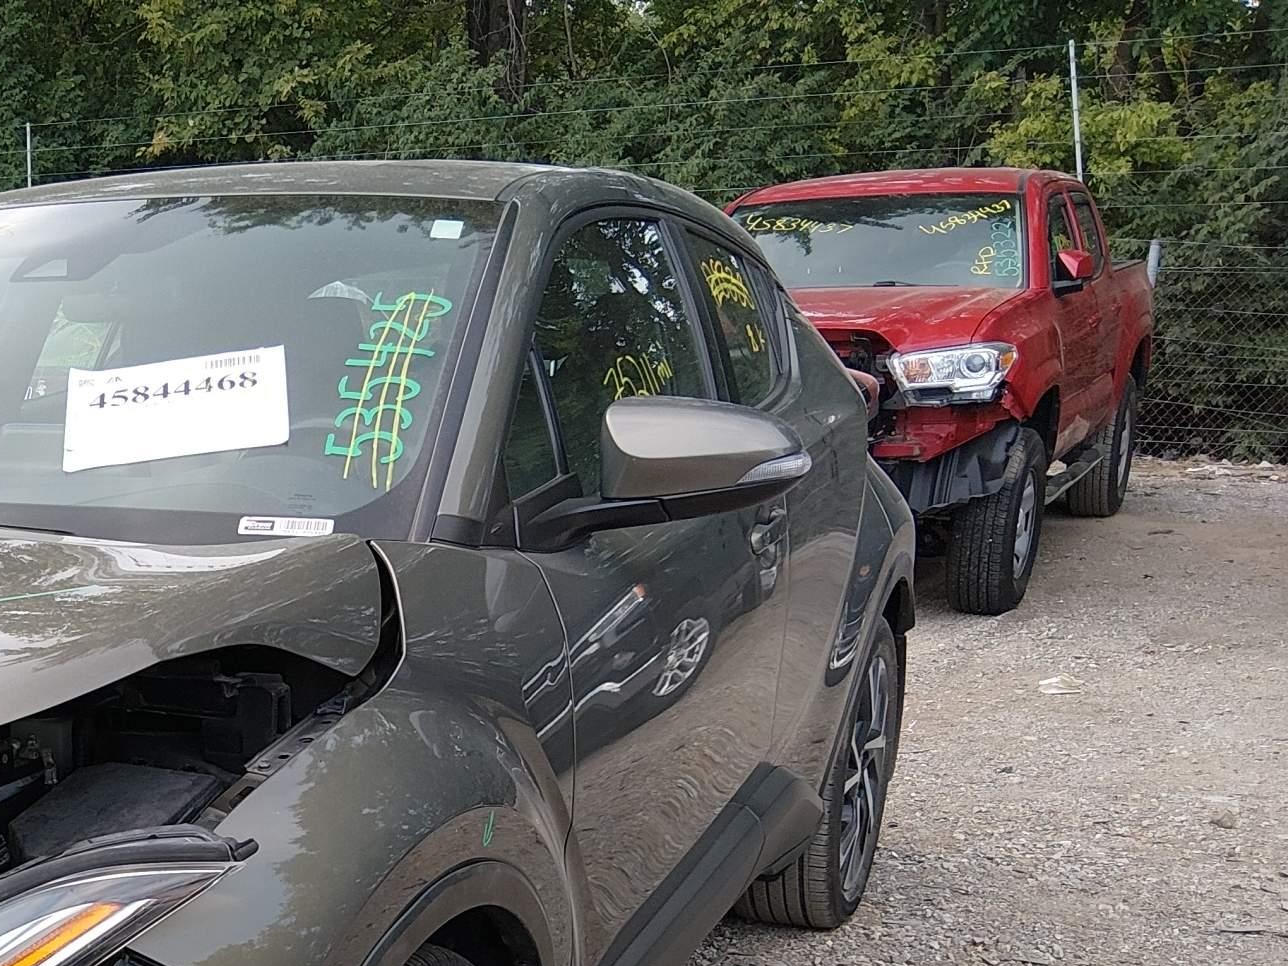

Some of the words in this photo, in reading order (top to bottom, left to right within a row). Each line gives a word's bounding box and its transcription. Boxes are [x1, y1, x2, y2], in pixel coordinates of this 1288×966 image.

[746, 213, 854, 234] 45834437
[919, 199, 1012, 235] 45834437
[88, 370, 259, 409] 45844468
[324, 291, 453, 464] 535425
